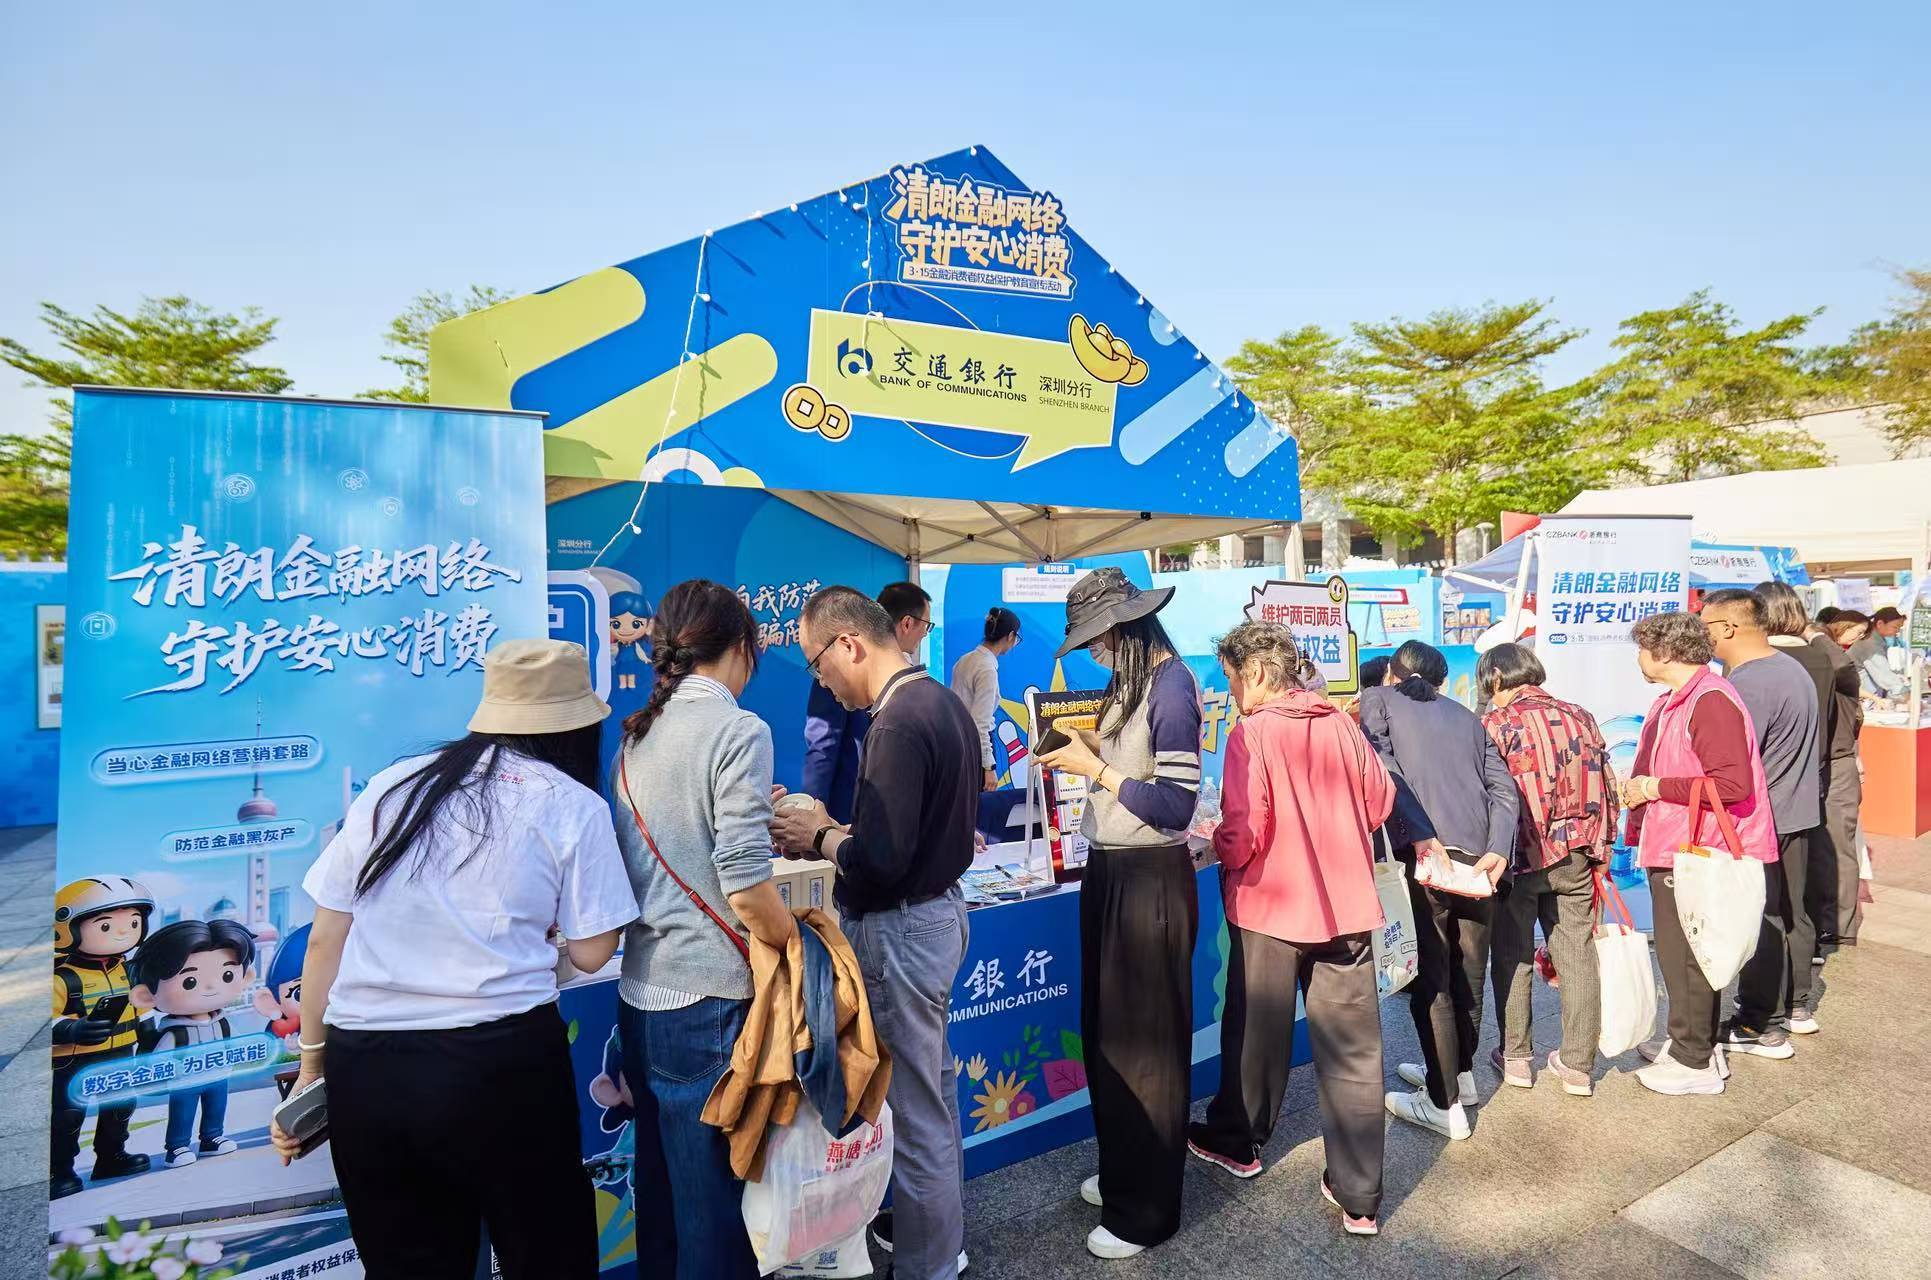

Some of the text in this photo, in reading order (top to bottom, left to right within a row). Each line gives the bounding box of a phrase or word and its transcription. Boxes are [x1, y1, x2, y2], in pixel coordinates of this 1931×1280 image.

[888, 167, 1064, 233] 清朗金融网络
[900, 219, 1072, 285] 守护安心消费
[893, 347, 1018, 390] 交通銀行
[1039, 375, 1093, 399] 深圳分行
[880, 374, 1028, 403] BANK OF COMMUNICATIONS
[1039, 396, 1110, 414] SHENZHEN BRANCH
[108, 524, 522, 608] 清朗金融网络
[1552, 571, 1681, 594] 清朗金融网络
[1262, 603, 1342, 627] 维护两司两员
[122, 603, 498, 700] 守护安心消费
[107, 741, 310, 774] 当心金融网络营销套路
[174, 826, 296, 853] 防范金融黑灰产
[949, 950, 1053, 1005] 銀行
[83, 1043, 267, 1096] 数字金融 为民赋能
